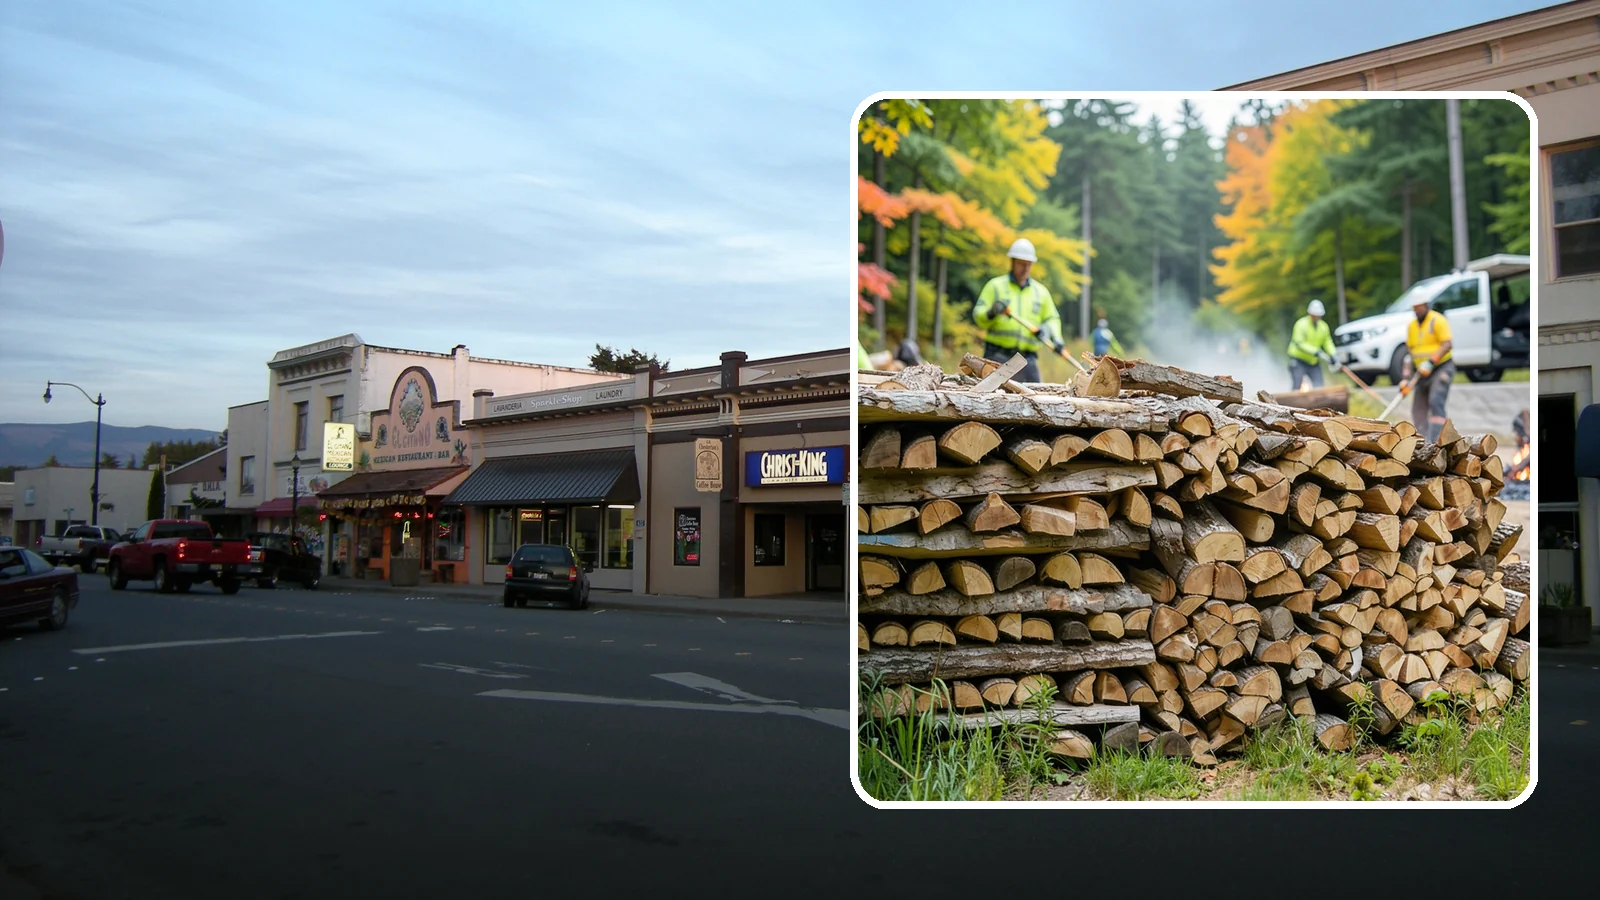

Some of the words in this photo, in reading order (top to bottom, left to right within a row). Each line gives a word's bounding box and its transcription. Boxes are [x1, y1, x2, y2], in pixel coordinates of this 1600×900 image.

[493, 402, 523, 412] LAVANDERIA
[562, 394, 582, 405] Shop
[595, 389, 623, 399] LAUNDRY
[374, 454, 396, 464] MEXICAN
[397, 451, 434, 462] RESTAURANT
[438, 450, 450, 459] BAR
[761, 452, 797, 478] CHRIST
[799, 450, 827, 476] KING
